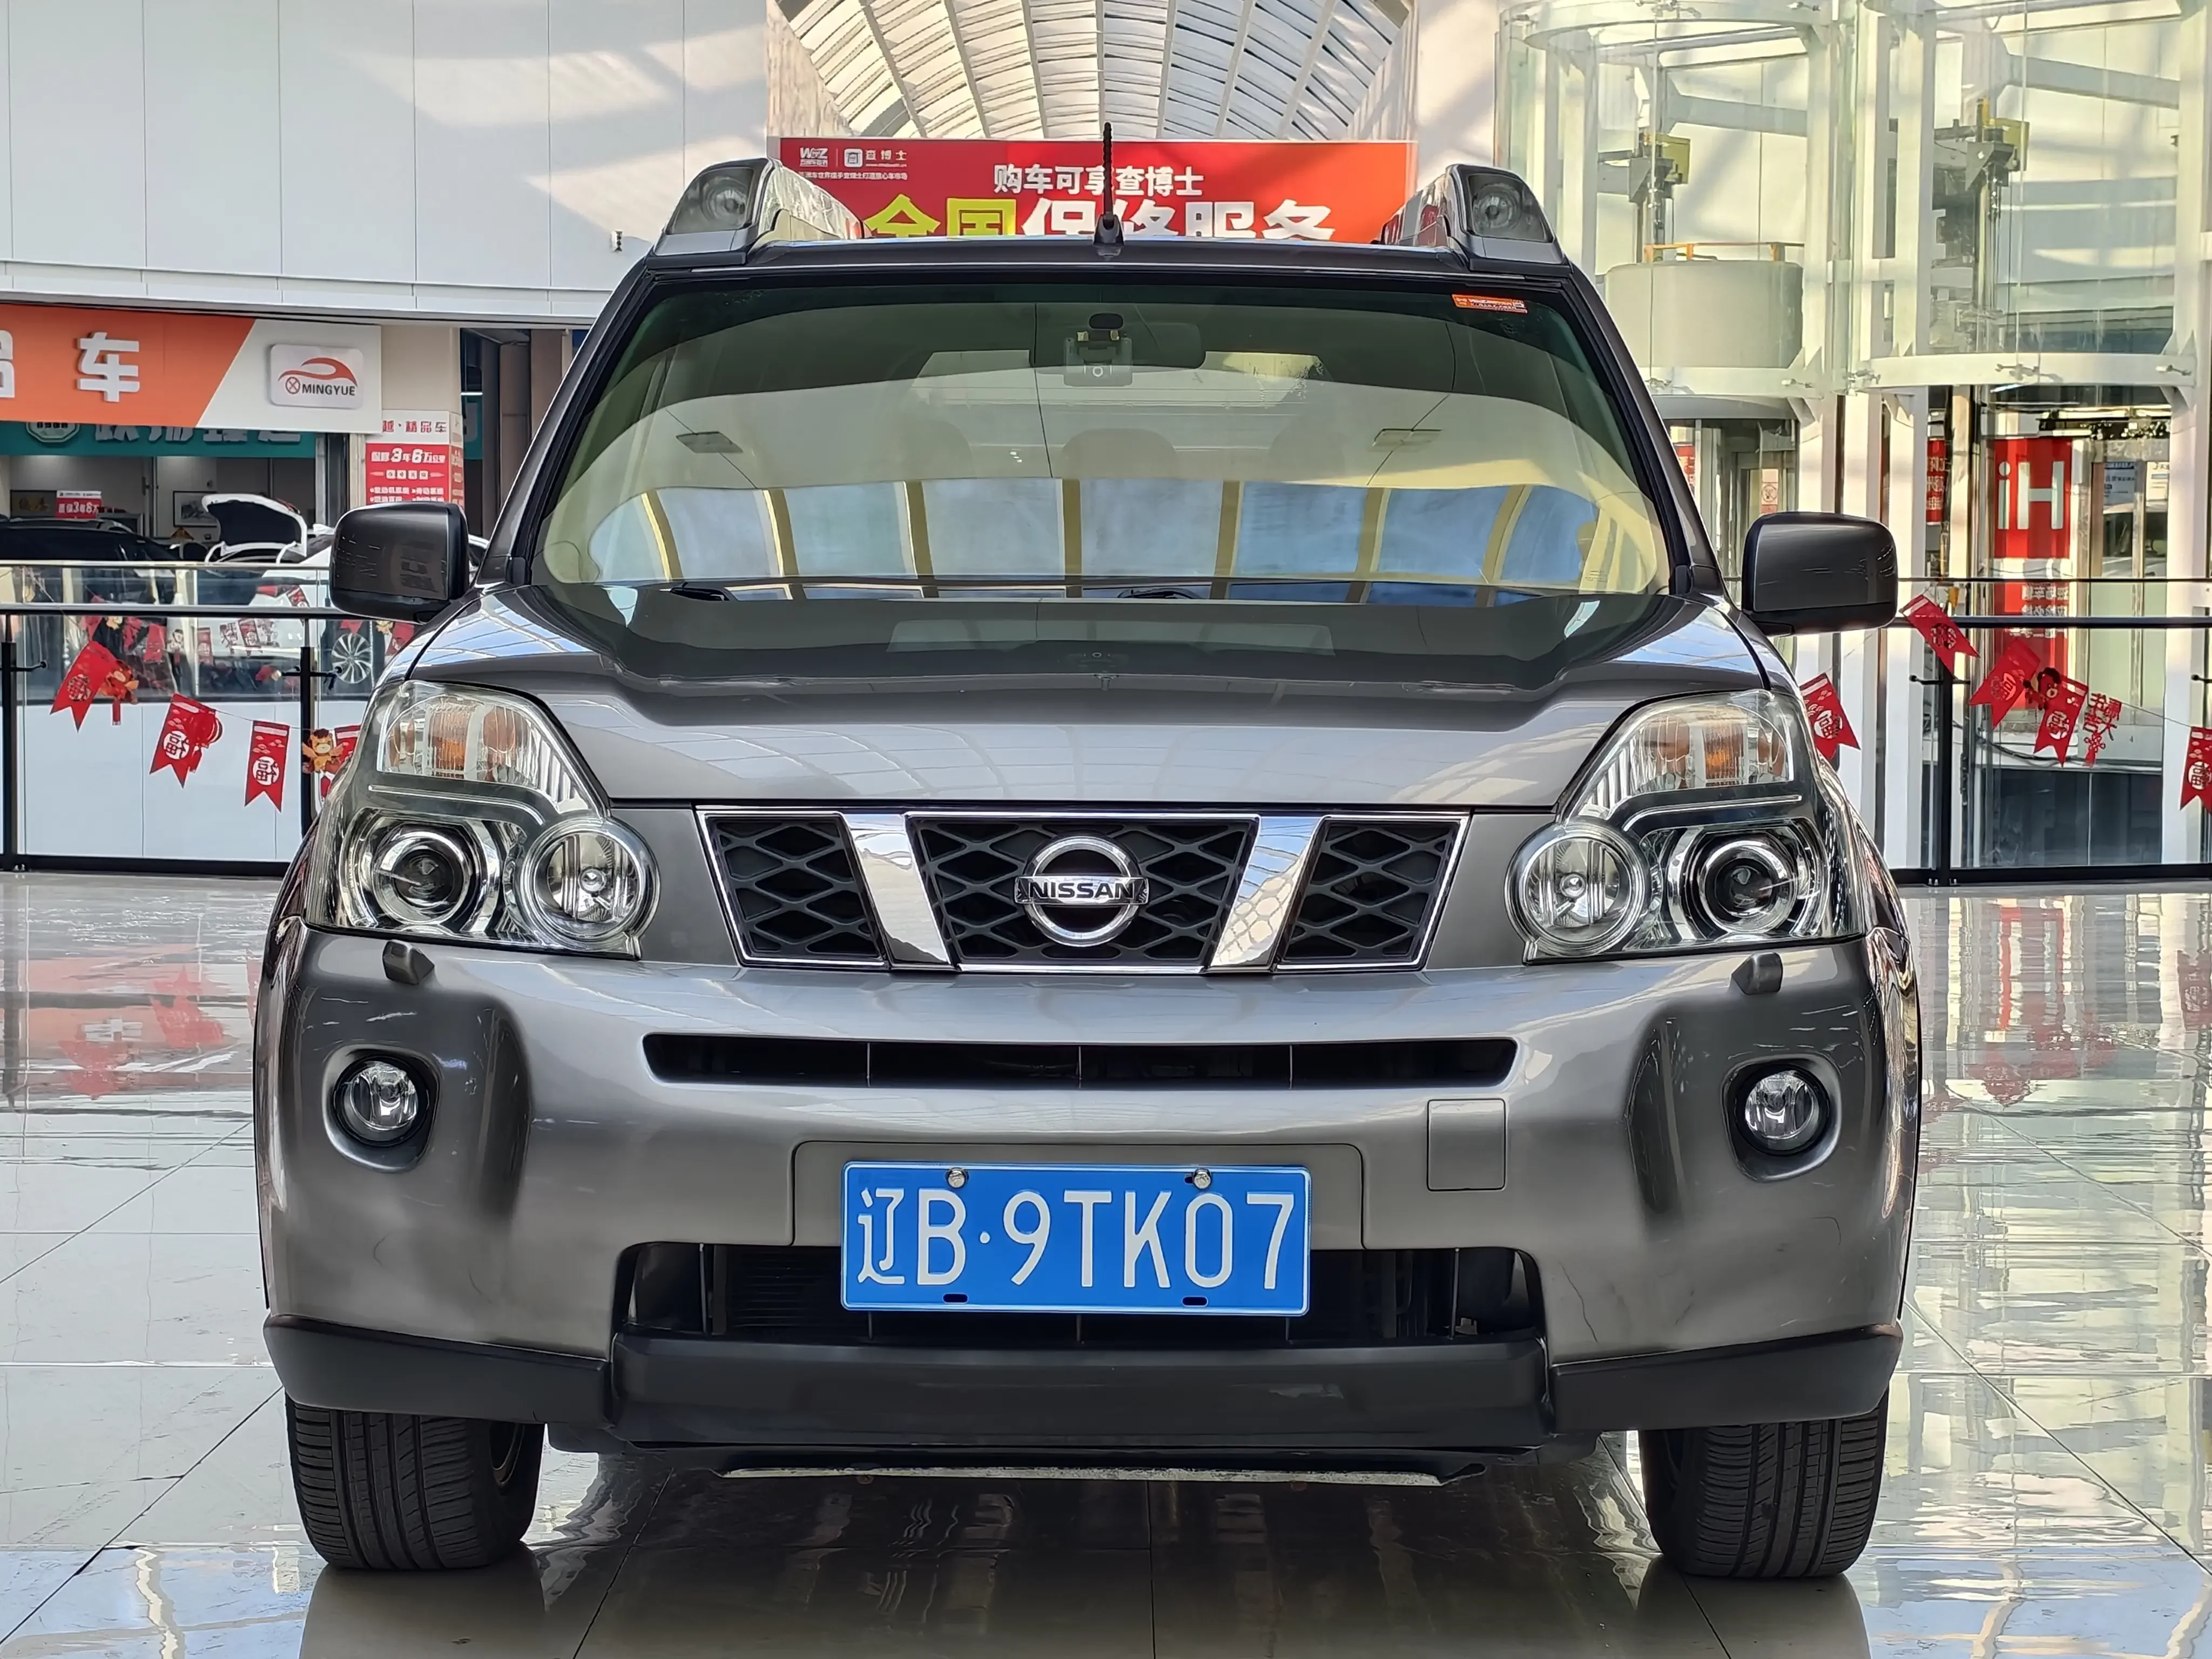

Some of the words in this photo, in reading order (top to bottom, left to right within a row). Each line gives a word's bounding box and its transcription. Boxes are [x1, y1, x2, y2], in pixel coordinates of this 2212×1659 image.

[994, 164, 1204, 197] 购车可享查博士
[302, 383, 355, 396] MINGYUE
[1029, 881, 1135, 899] NISSAN
[857, 1188, 1294, 1290] 辽B·9TK07
